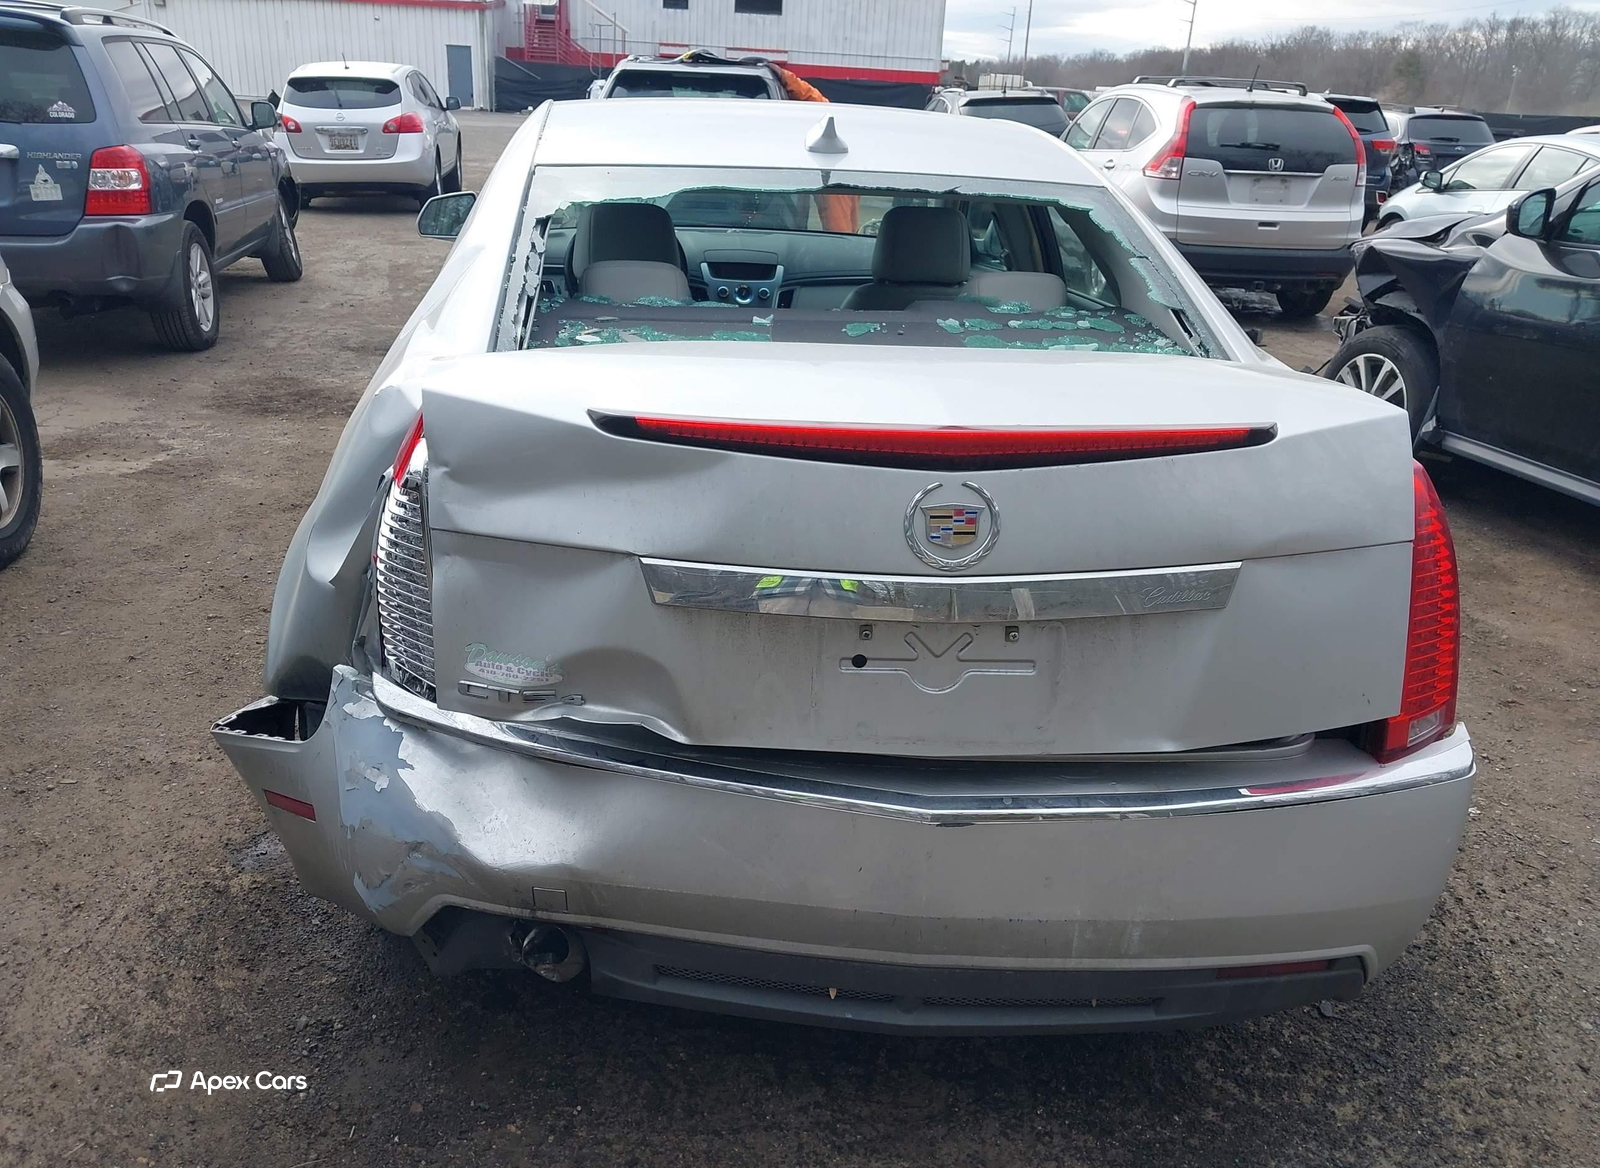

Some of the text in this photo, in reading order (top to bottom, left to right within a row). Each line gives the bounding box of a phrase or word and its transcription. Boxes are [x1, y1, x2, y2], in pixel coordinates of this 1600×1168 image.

[49, 111, 75, 119] COLORADO
[27, 151, 82, 160] HIGHLANDER
[1142, 586, 1211, 608] Cadillac
[474, 660, 503, 671] Auto
[517, 666, 553, 678] Cycle
